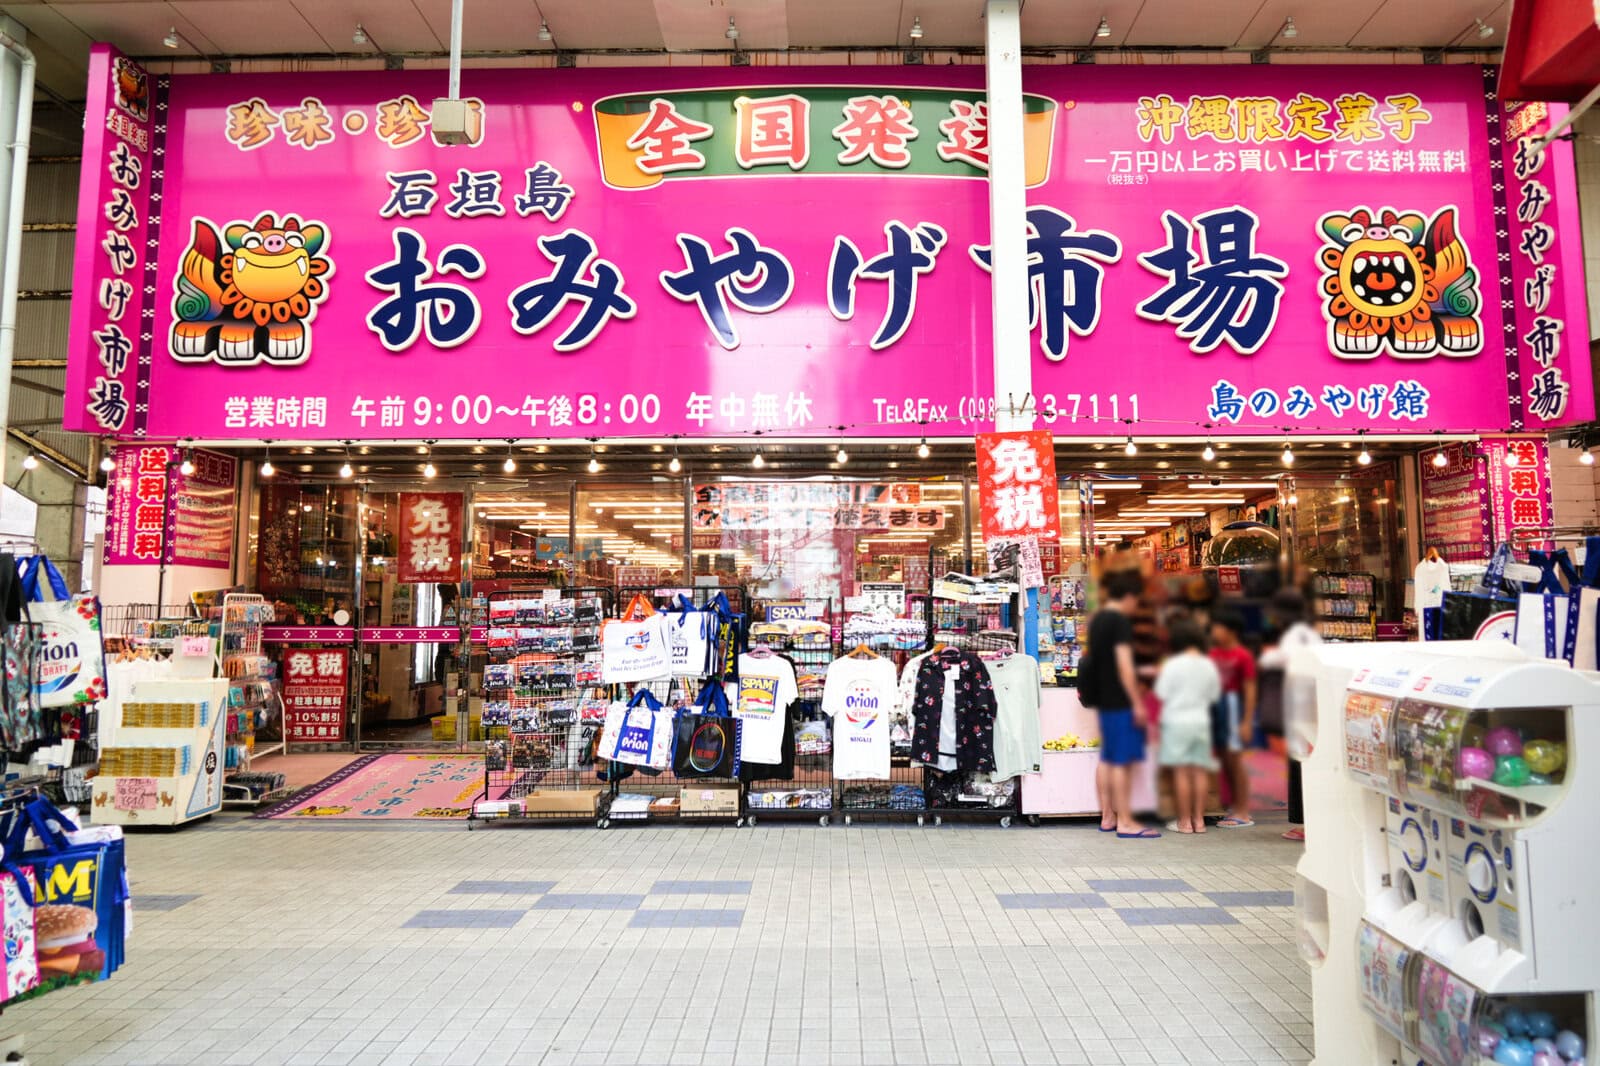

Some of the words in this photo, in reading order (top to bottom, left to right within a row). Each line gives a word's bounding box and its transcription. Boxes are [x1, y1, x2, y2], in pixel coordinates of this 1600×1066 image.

[225, 97, 484, 151] 珍味・珍
[1137, 93, 1431, 143] 沖縄限定菓子
[1084, 149, 1467, 173] 一万円以上お買い上げで送料無料
[379, 161, 576, 220] 石垣島
[87, 142, 141, 431] おみやげ市場
[365, 205, 1289, 361] おみやげ市場
[1513, 136, 1569, 420] おみやげ市場
[224, 396, 327, 428] 営業時間
[686, 392, 813, 427] 年中無休
[1207, 381, 1429, 420] 島のみやげ館
[134, 447, 168, 559] 送料無料
[989, 438, 1047, 530] 免税
[410, 499, 452, 573] 免税
[287, 652, 343, 676] 免税
[741, 678, 773, 691] SPAM
[294, 712, 340, 721] 10%割引
[845, 693, 879, 710] Orion
[294, 726, 340, 736] 送料無料
[621, 737, 649, 751] Orion
